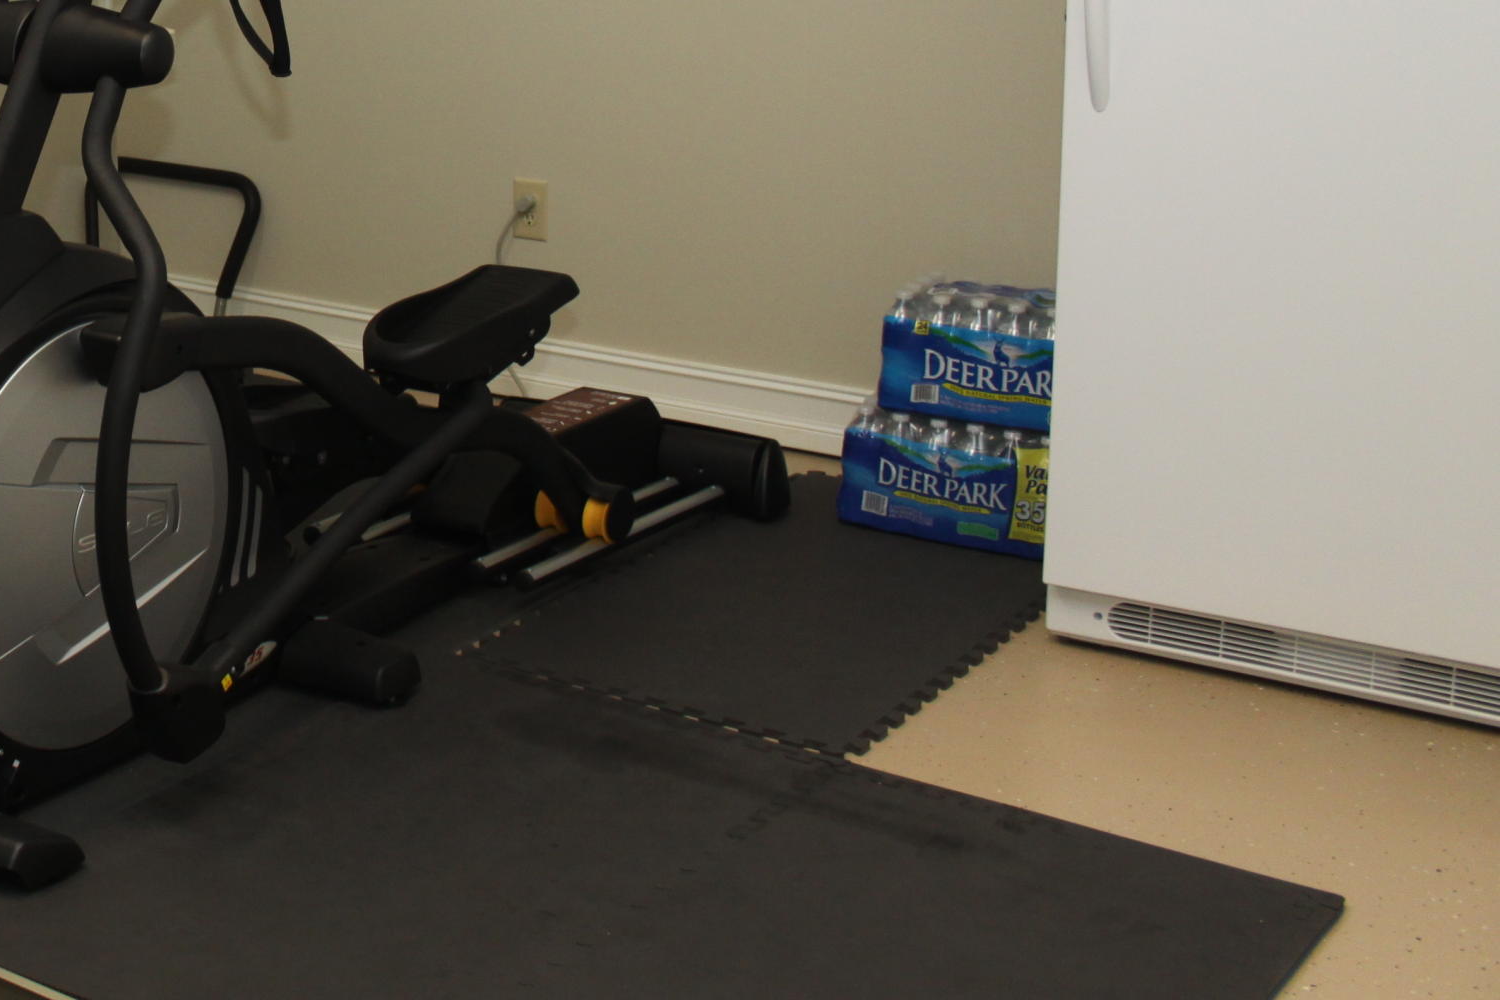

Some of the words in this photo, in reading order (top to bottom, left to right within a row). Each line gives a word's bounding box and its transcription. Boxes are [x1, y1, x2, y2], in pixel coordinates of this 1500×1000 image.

[923, 348, 999, 392] DEER
[1001, 368, 1053, 397] PAR
[877, 457, 941, 498] DEER
[944, 478, 1008, 511] PARK
[77, 507, 165, 554] SLE
[1015, 500, 1045, 524] 35
